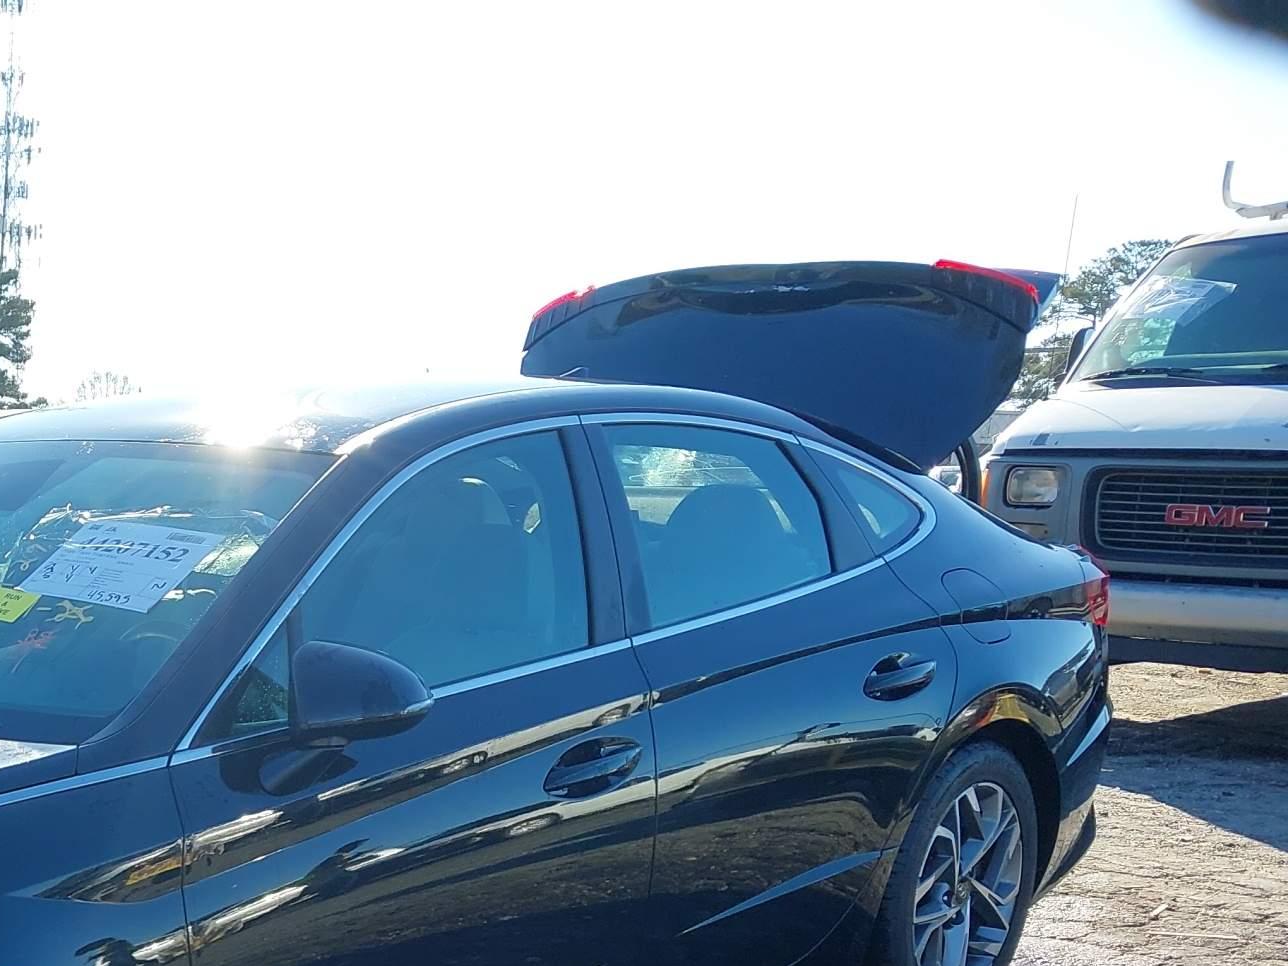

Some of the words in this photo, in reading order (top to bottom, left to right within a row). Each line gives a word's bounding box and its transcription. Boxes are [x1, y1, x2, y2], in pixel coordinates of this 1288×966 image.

[1165, 504, 1270, 528] GMC
[81, 537, 190, 562] 44207152
[3, 592, 23, 601] RUN
